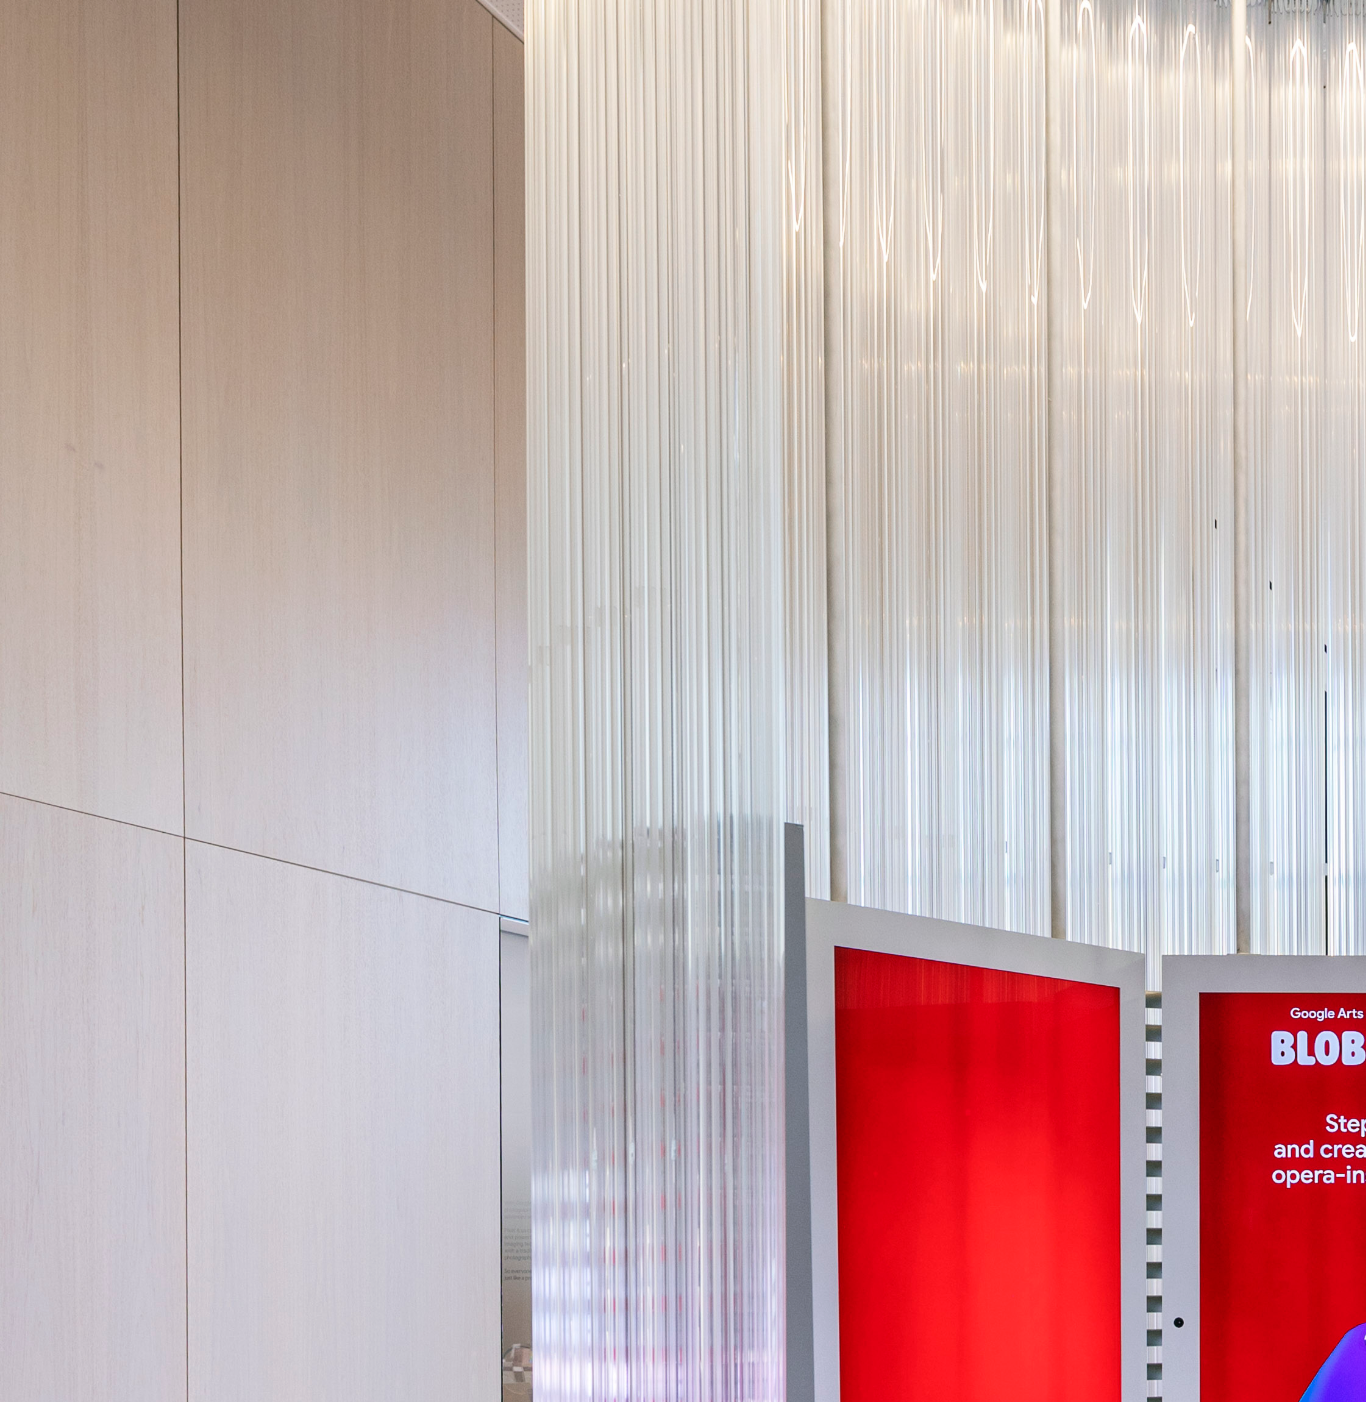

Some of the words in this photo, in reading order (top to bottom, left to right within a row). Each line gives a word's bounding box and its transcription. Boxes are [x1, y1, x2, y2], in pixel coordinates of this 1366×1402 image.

[1290, 1008, 1335, 1021] Google
[1337, 1008, 1364, 1019] Arts
[1270, 1030, 1366, 1066] BLOB
[1273, 1140, 1314, 1159] and
